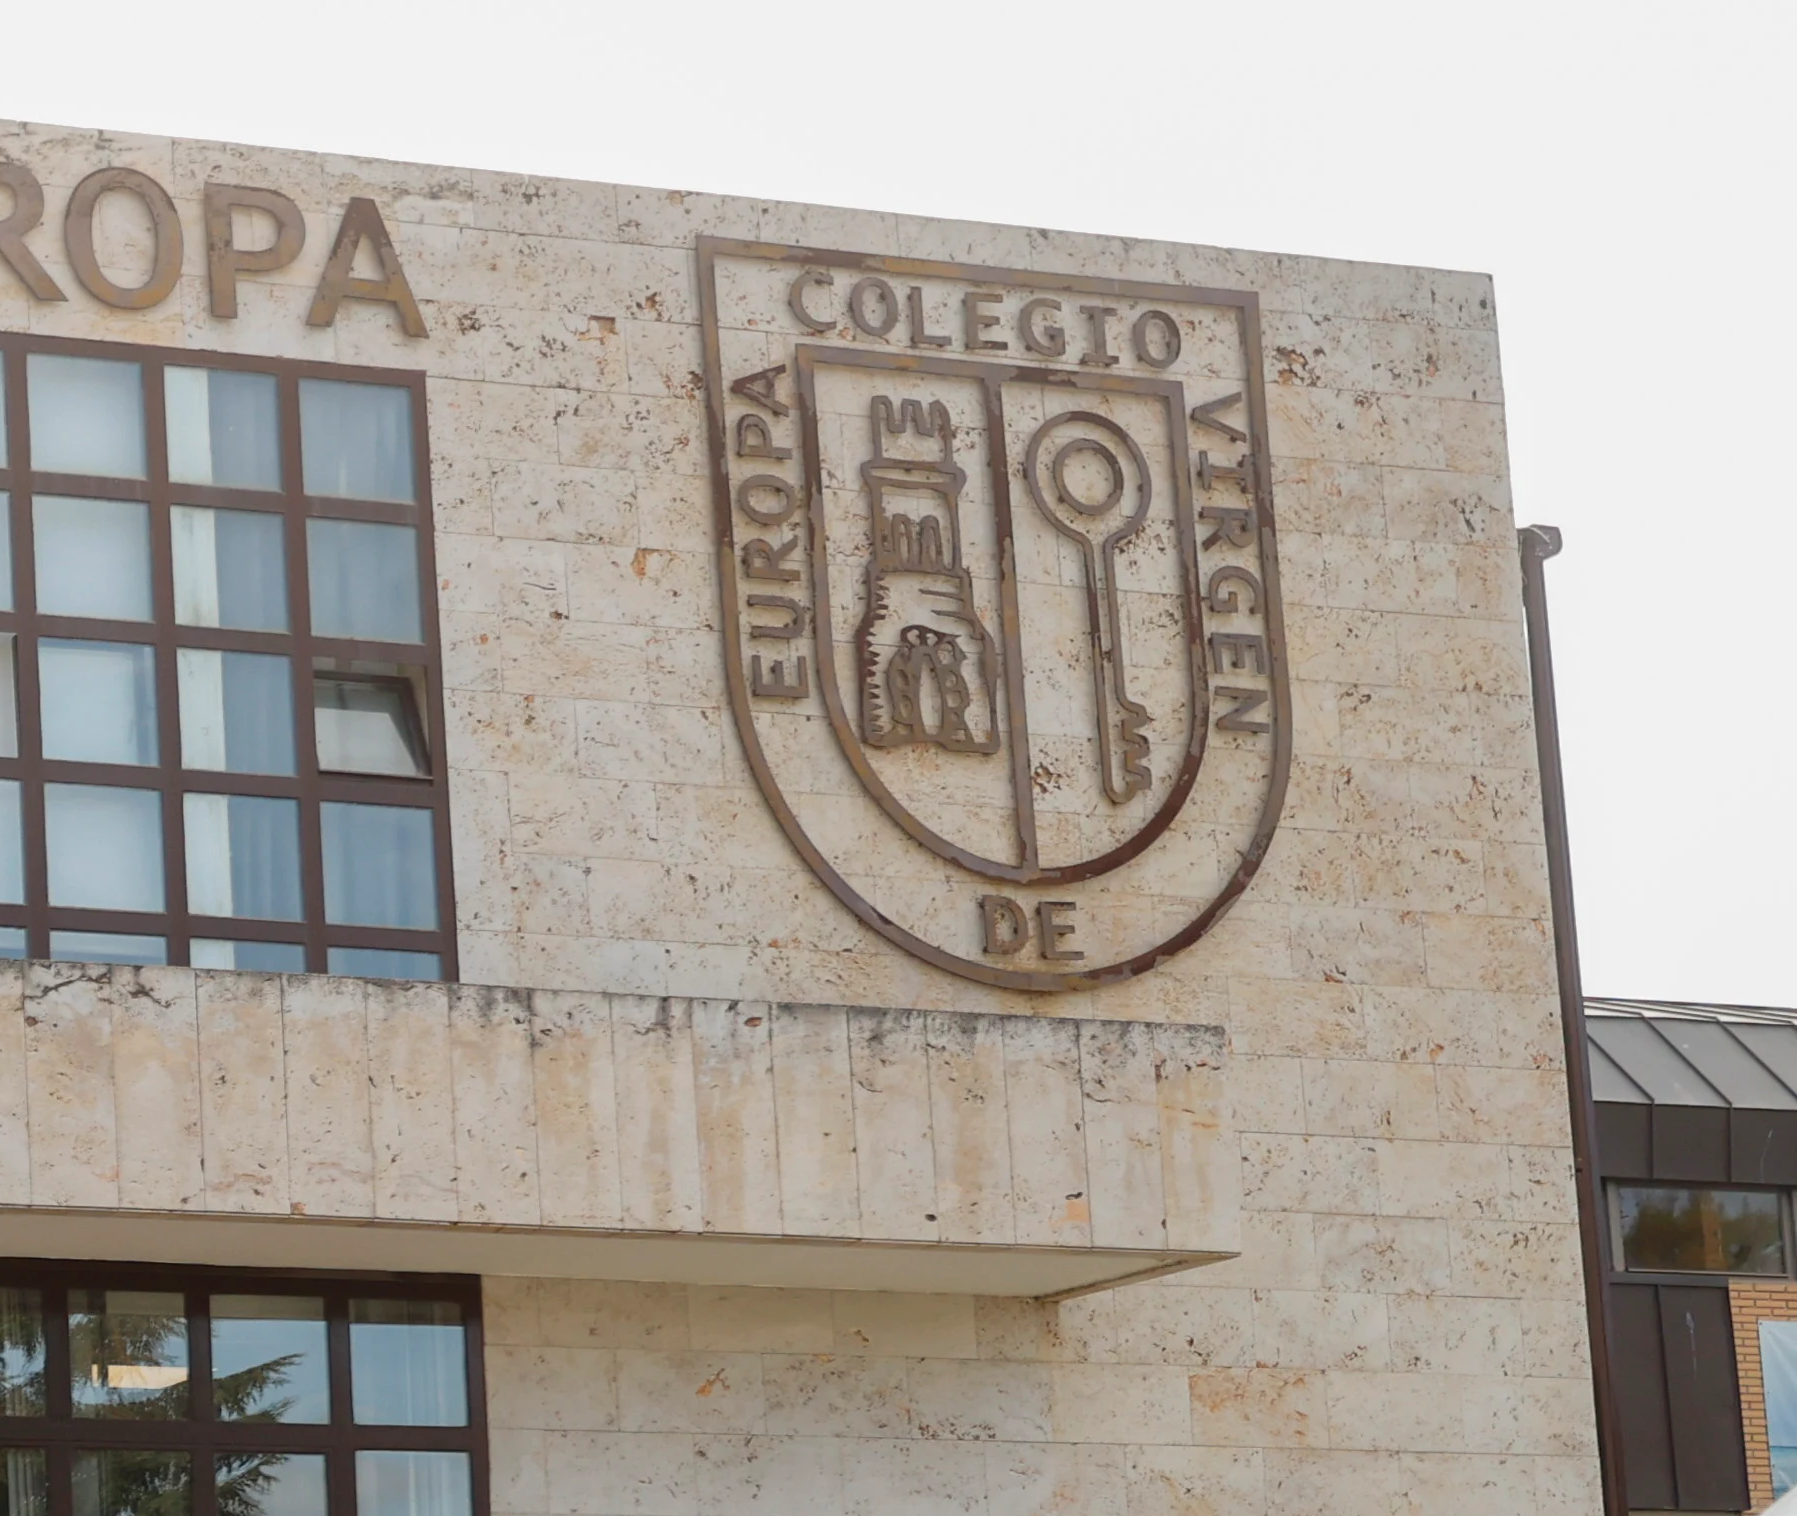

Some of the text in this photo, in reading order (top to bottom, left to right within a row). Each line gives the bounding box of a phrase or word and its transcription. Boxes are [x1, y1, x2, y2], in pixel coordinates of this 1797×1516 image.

[789, 271, 1182, 369] COLEGIO
[730, 362, 808, 701] EUROPA
[1191, 391, 1271, 734] VIRGEN
[981, 894, 1085, 962] DE
